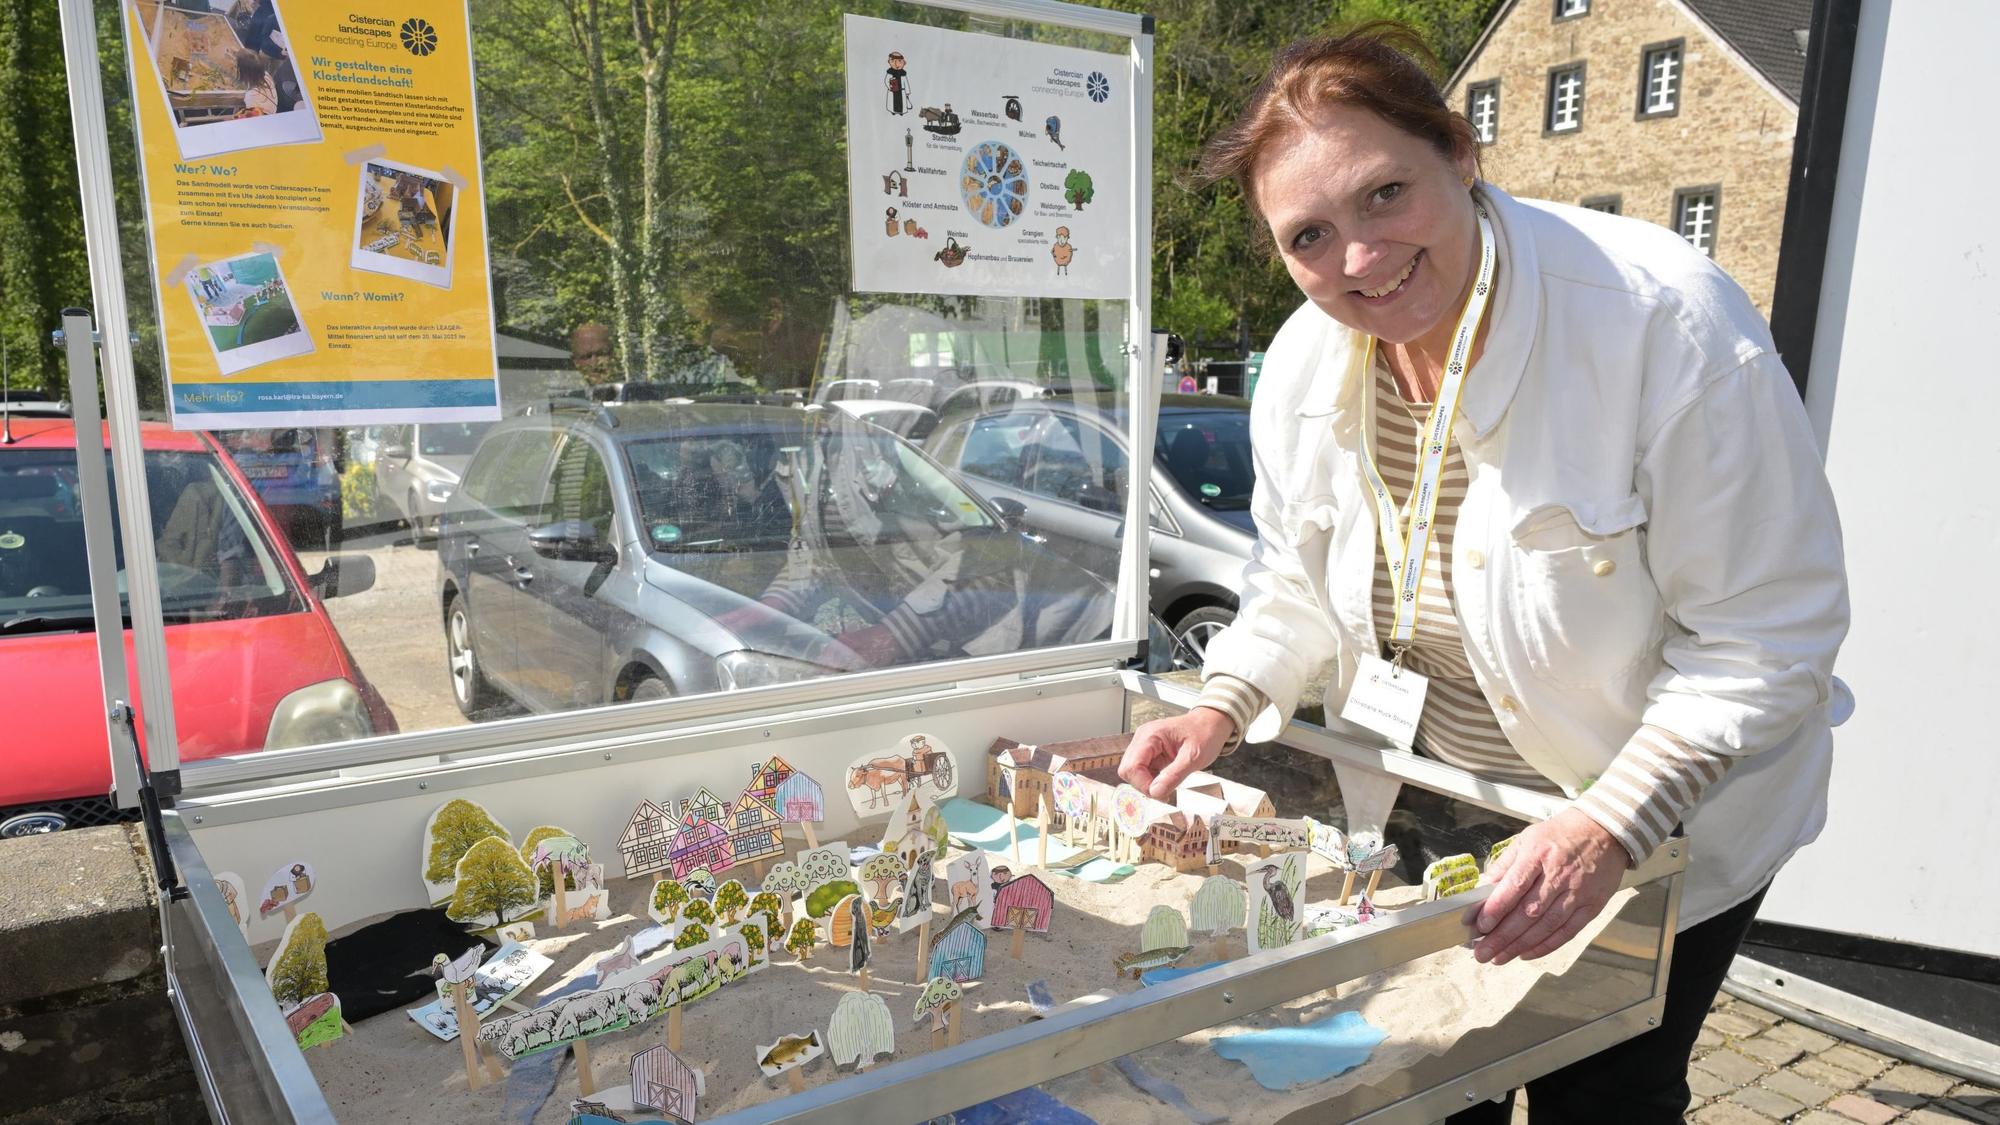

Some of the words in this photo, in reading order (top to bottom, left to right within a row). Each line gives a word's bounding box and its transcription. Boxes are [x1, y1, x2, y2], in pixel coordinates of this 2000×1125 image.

[349, 14, 395, 27] Cistercian
[338, 24, 392, 38] landscapes
[314, 34, 364, 48] connecting
[366, 40, 398, 50] Europe
[312, 56, 331, 67] Wir
[335, 59, 386, 73] gestalten
[389, 65, 413, 75] eine
[313, 70, 414, 88] Klosterlandschaft!
[1053, 68, 1084, 79] Cistercian
[1046, 76, 1081, 88] landscapes
[347, 88, 372, 96] mobilen
[373, 91, 403, 99] Sandtisch
[338, 97, 373, 105] gestalteten
[404, 103, 465, 112] Klosterlandschaften
[354, 107, 401, 116] Klosterkomplex
[971, 109, 999, 119] Wasserbau
[343, 115, 377, 123] vorhanden.
[320, 122, 345, 130] bemalt,
[346, 124, 393, 133] ausgeschnitten
[1018, 130, 1037, 139] Mühlen
[173, 163, 207, 175] Wer?
[210, 165, 238, 176] Wo?
[1032, 159, 1067, 169] Teichwirtschaft
[918, 166, 948, 176] Wallfahrten
[191, 180, 231, 188] Sandmodell
[1040, 182, 1060, 191] Obstbau
[275, 194, 308, 202] konzipiert
[278, 204, 330, 212] Veranstaltungen
[902, 200, 922, 209] Klöster
[1040, 202, 1067, 211] Waldungen
[946, 230, 968, 238] Weinbau
[967, 253, 1000, 261] Hopfenanbau
[1008, 255, 1034, 263] Brauereien
[321, 291, 360, 301] Wann?
[363, 292, 405, 301] Womit?
[1454, 326, 1467, 361] CISTERSCAPES
[184, 391, 213, 403] Mehr
[216, 389, 245, 403] Info?
[1433, 405, 1446, 441] CISTERSCAPES
[1418, 482, 1429, 517] CISTERSCAPES
[1405, 558, 1415, 589] CISTERSCAPES
